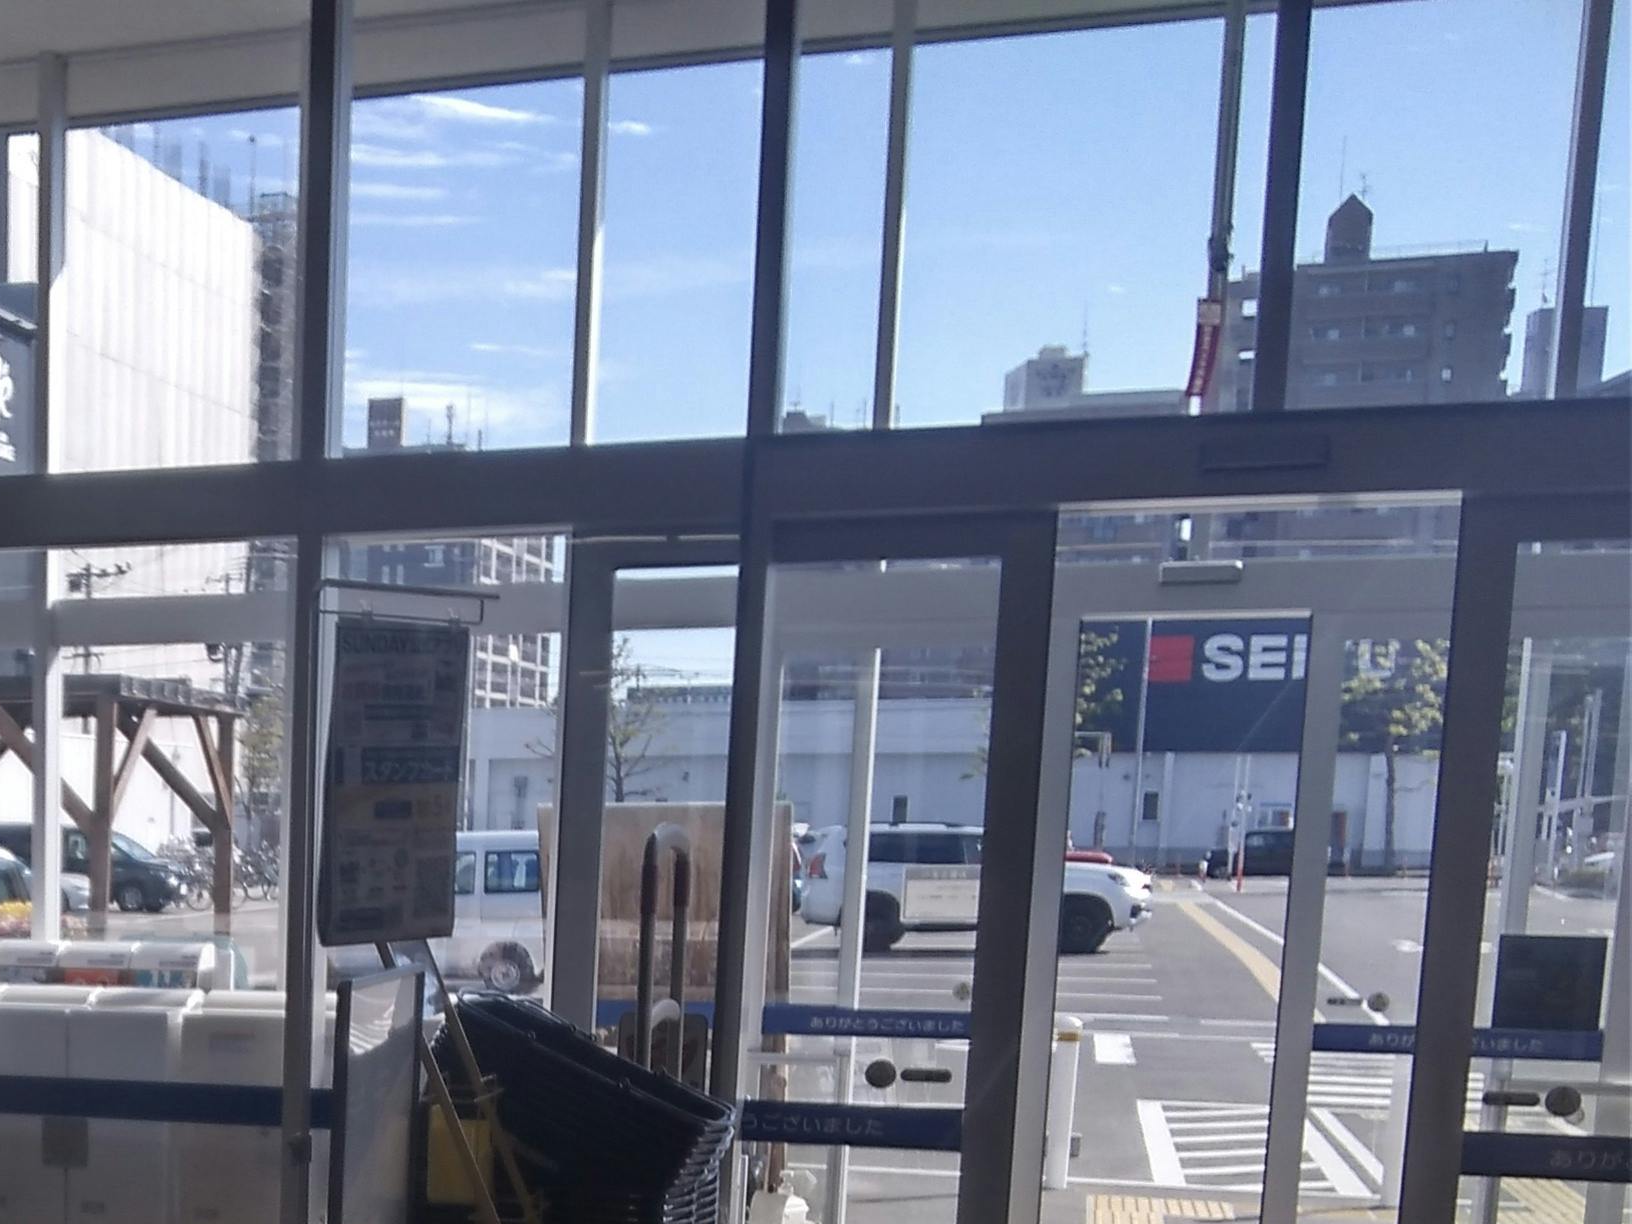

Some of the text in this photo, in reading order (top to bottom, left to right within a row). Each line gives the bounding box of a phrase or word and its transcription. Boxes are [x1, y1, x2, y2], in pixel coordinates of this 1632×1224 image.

[1201, 633, 1400, 683] SEIU
[809, 1015, 966, 1032] ありがとうございました
